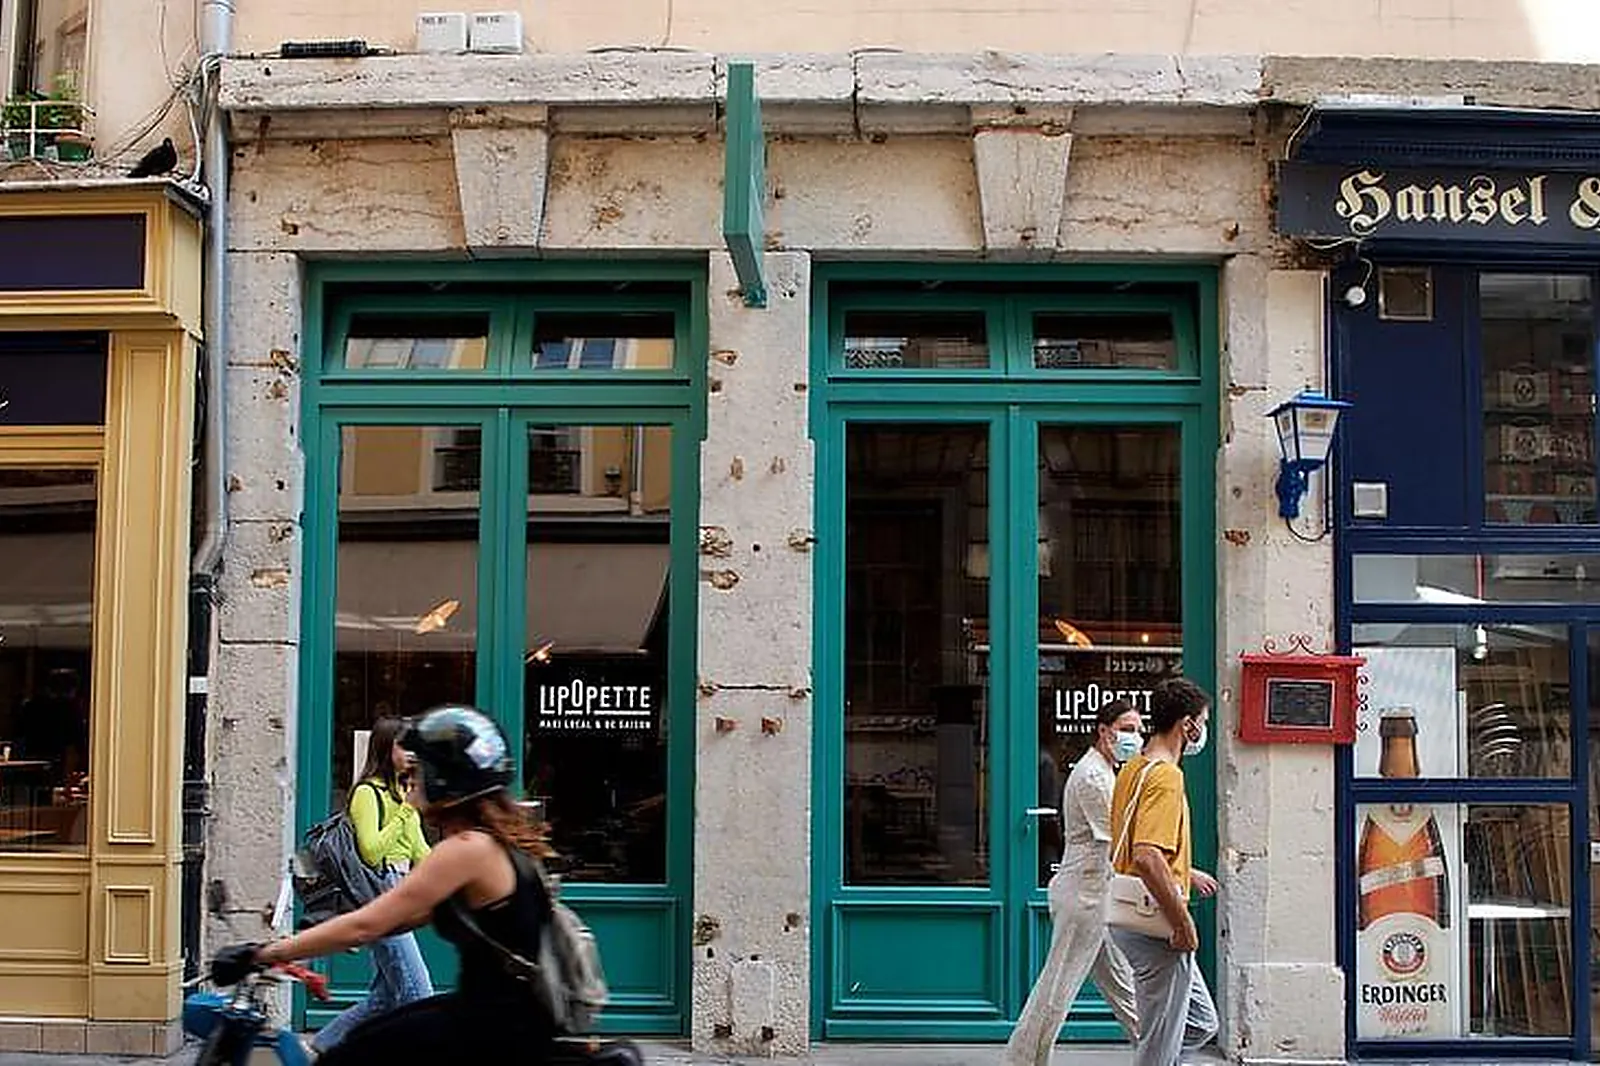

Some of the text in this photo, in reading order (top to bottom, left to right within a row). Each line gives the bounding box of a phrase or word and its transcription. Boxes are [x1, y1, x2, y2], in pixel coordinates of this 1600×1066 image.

[1335, 170, 1547, 235] Hansel
[540, 679, 651, 716] LIPOPETTE
[1362, 984, 1447, 1006] ERDINGER
